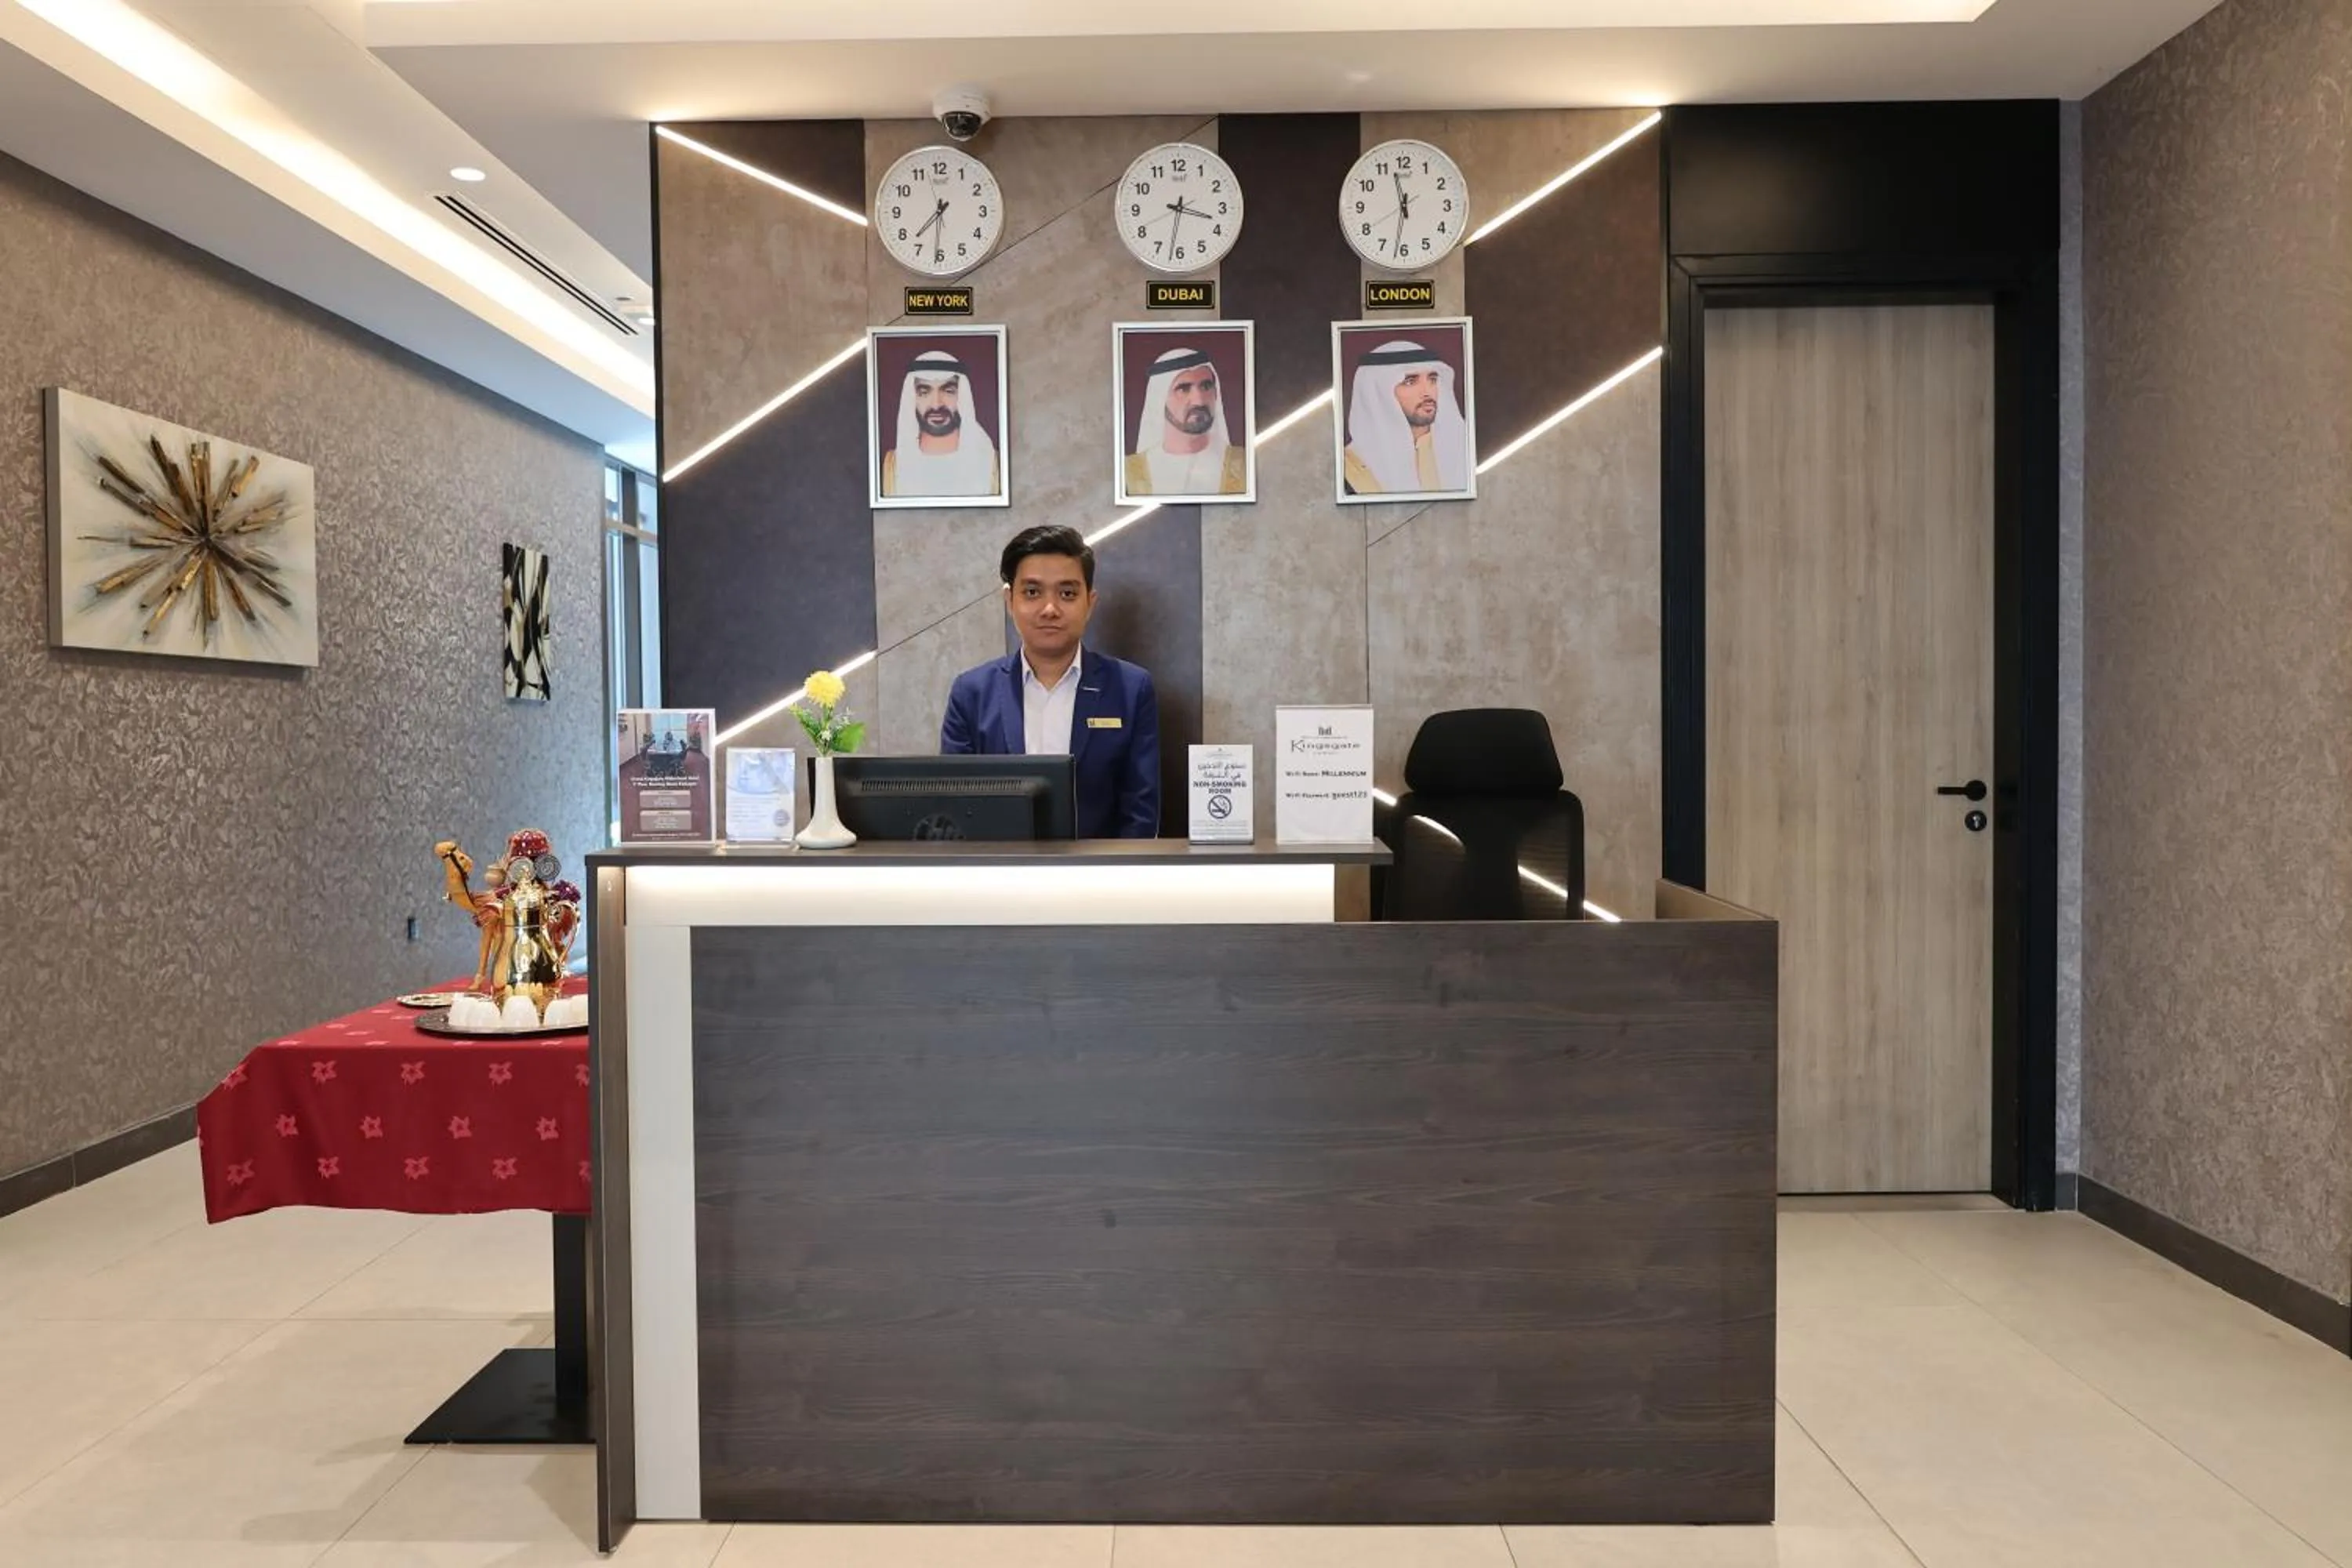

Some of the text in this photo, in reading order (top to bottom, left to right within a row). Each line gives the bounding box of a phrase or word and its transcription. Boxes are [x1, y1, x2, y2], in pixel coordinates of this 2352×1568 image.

[1171, 159, 1185, 171] 12
[1396, 157, 1410, 168] 12
[1422, 162, 1428, 174] 1
[912, 169, 924, 180] 11
[932, 163, 947, 175] 12
[958, 169, 964, 180] 1
[1151, 166, 1163, 178] 11
[1198, 165, 1203, 176] 1
[1376, 163, 1388, 175] 11
[972, 183, 982, 195] 2
[1135, 183, 1150, 194] 10
[1211, 180, 1221, 192] 2
[1359, 180, 1374, 191] 10
[1437, 178, 1446, 190] 2
[896, 185, 910, 197] 10
[979, 205, 987, 217] 3
[1131, 205, 1140, 216] 9
[1218, 202, 1227, 214] 3
[1356, 201, 1364, 213] 9
[1443, 200, 1452, 212] 3
[892, 207, 901, 219] 9
[973, 227, 982, 239] 4
[1138, 226, 1147, 238] 8
[1213, 224, 1221, 236] 4
[1362, 223, 1371, 235] 8
[1437, 221, 1446, 233] 4
[898, 228, 907, 240] 8
[914, 244, 923, 256] 7
[957, 243, 966, 256] 5
[1154, 241, 1163, 254] 7
[1197, 241, 1206, 253] 5
[1377, 238, 1386, 250] 7
[1422, 238, 1430, 250] 5
[936, 250, 945, 262] 6
[1175, 247, 1185, 259] 6
[1399, 245, 1408, 256] 6
[1158, 289, 1203, 300] DUBAI
[1370, 289, 1430, 300] LONDON
[909, 295, 968, 307] NEW YORK
